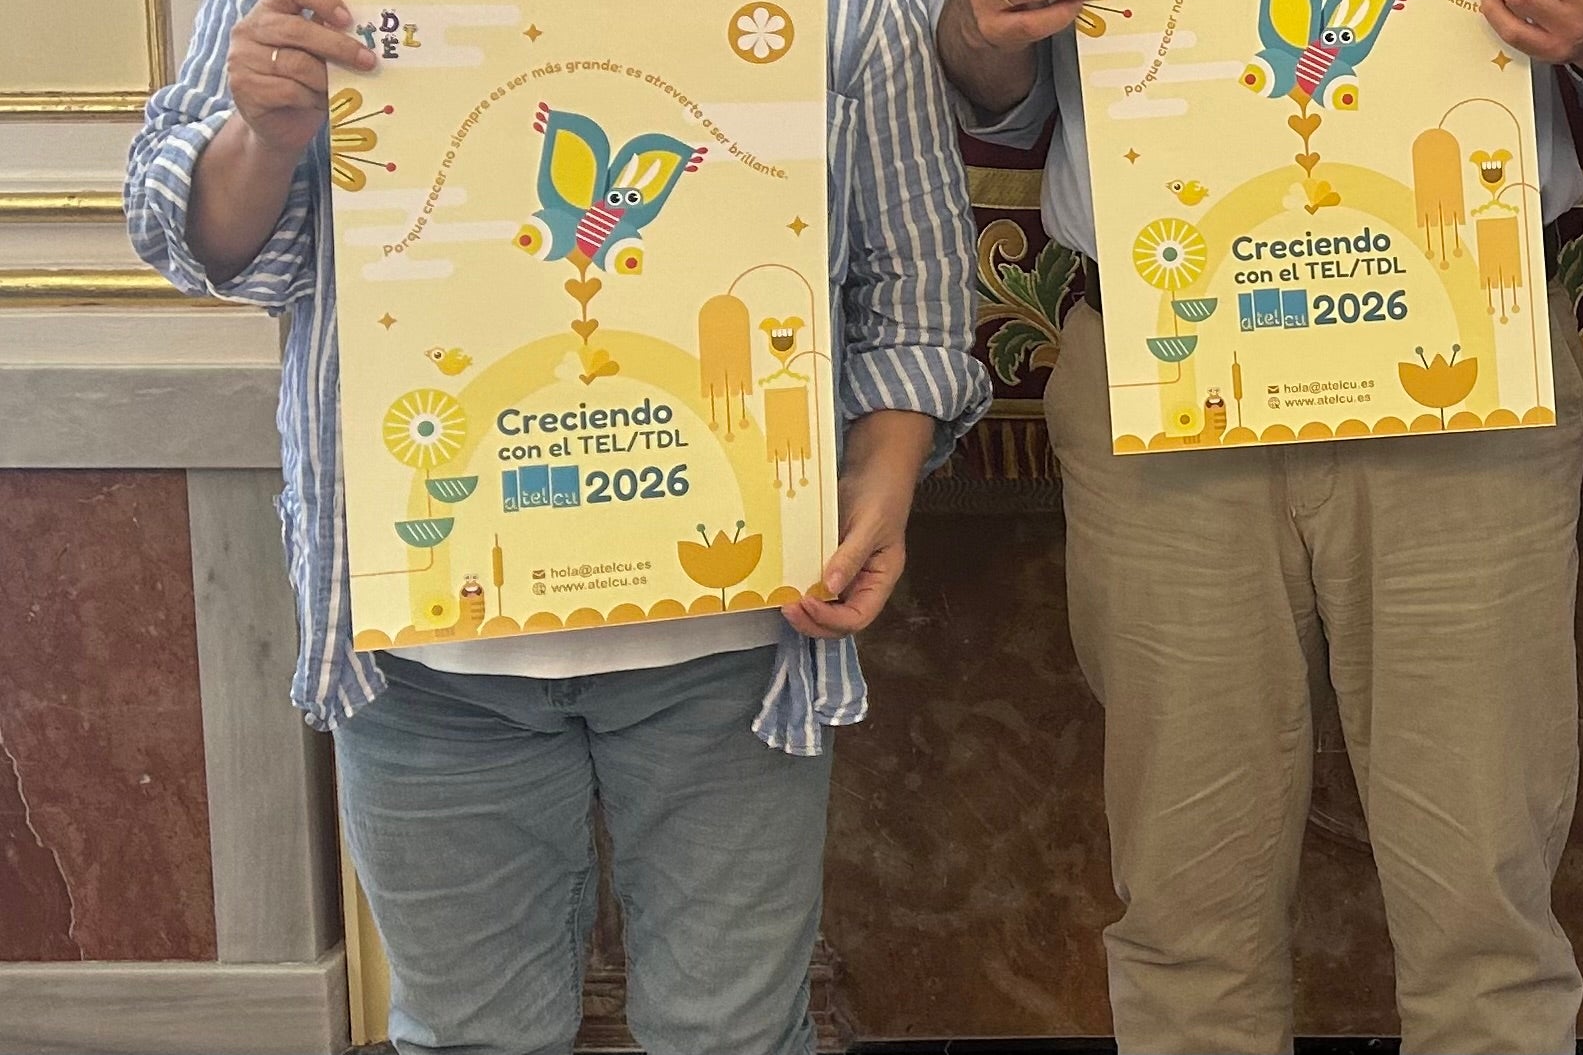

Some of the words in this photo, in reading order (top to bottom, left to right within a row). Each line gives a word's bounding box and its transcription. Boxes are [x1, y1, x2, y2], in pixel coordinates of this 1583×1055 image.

[1124, 59, 1162, 97] Porque
[1158, 15, 1177, 56] crecer
[383, 217, 427, 257] Porque
[423, 170, 446, 214] crecer
[442, 151, 455, 168] no
[451, 100, 490, 149] siempre
[490, 86, 507, 101] es
[506, 73, 528, 91] ser
[531, 62, 561, 79] más
[625, 65, 641, 78] es
[644, 73, 703, 119] atreverte
[710, 125, 730, 144] ser
[1232, 227, 1391, 261] Creciendo
[1234, 270, 1273, 284] con
[1279, 262, 1299, 281] el
[1304, 257, 1407, 279] TEL/TDL
[1313, 289, 1408, 325] 2026
[1284, 380, 1375, 394] hola@atelcu.es
[1285, 394, 1371, 407] www.atelcu.es
[497, 397, 673, 436] Creciendo
[498, 445, 542, 461] con
[549, 437, 571, 457] el
[577, 429, 689, 454] TEL/TDL
[585, 464, 689, 504] 2026
[550, 561, 652, 578] hola@atelcu.es
[551, 576, 647, 593] www.atelcu.es
